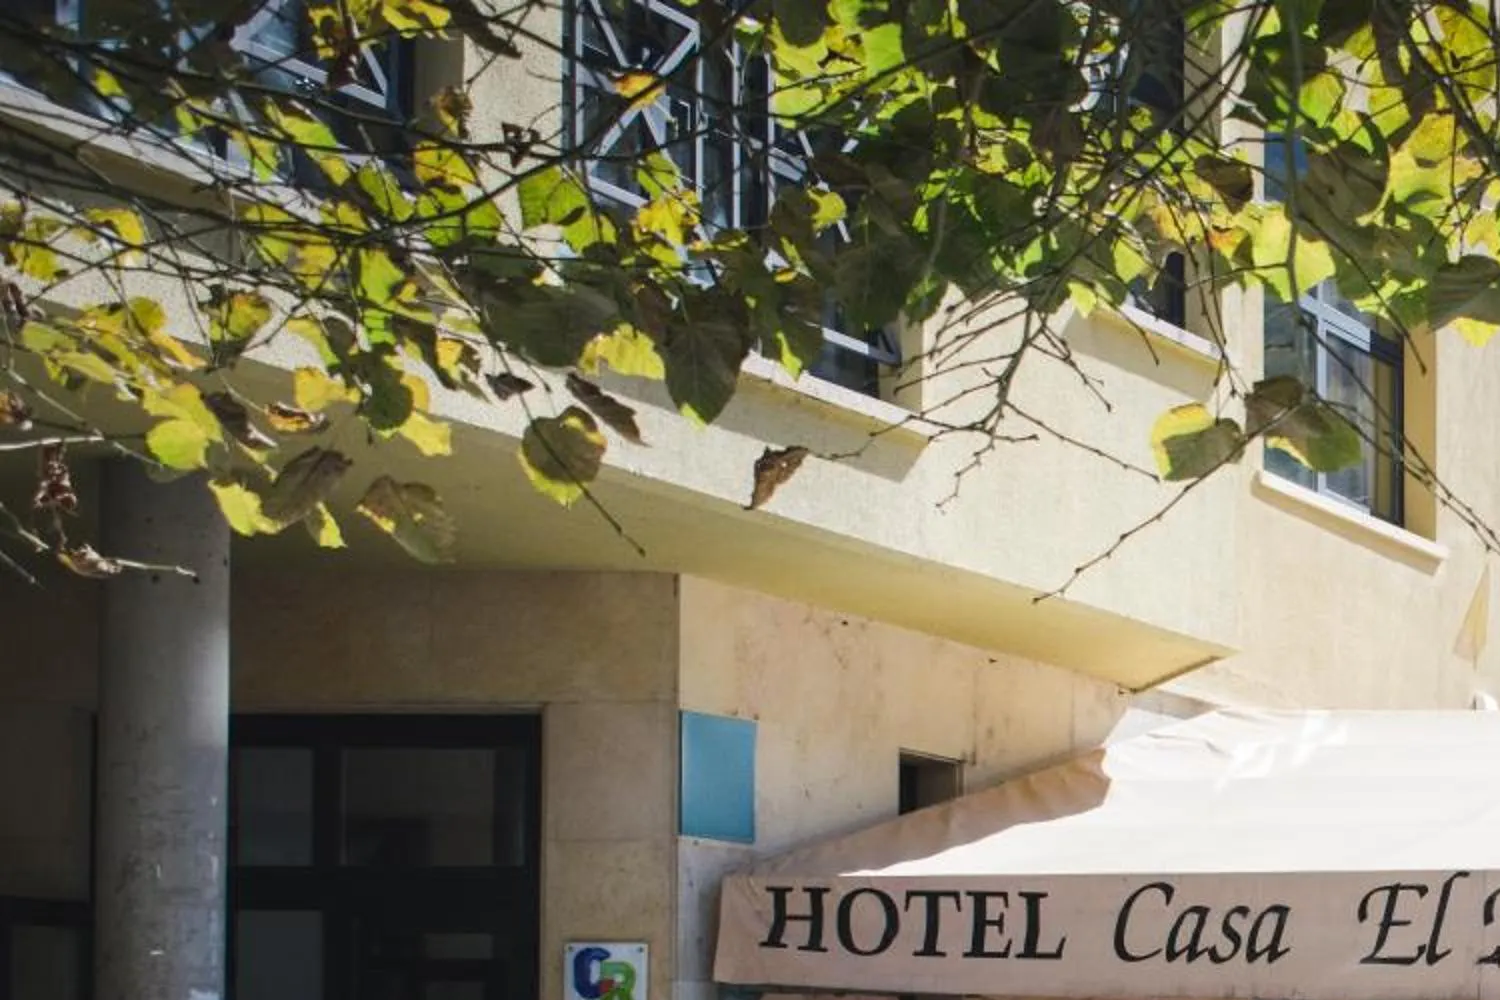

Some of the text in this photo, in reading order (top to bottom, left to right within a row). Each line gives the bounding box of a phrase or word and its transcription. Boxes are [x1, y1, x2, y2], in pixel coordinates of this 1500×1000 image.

[758, 886, 1066, 960] HOTEL
[1113, 882, 1291, 964] Casa
[1357, 871, 1470, 966] El
